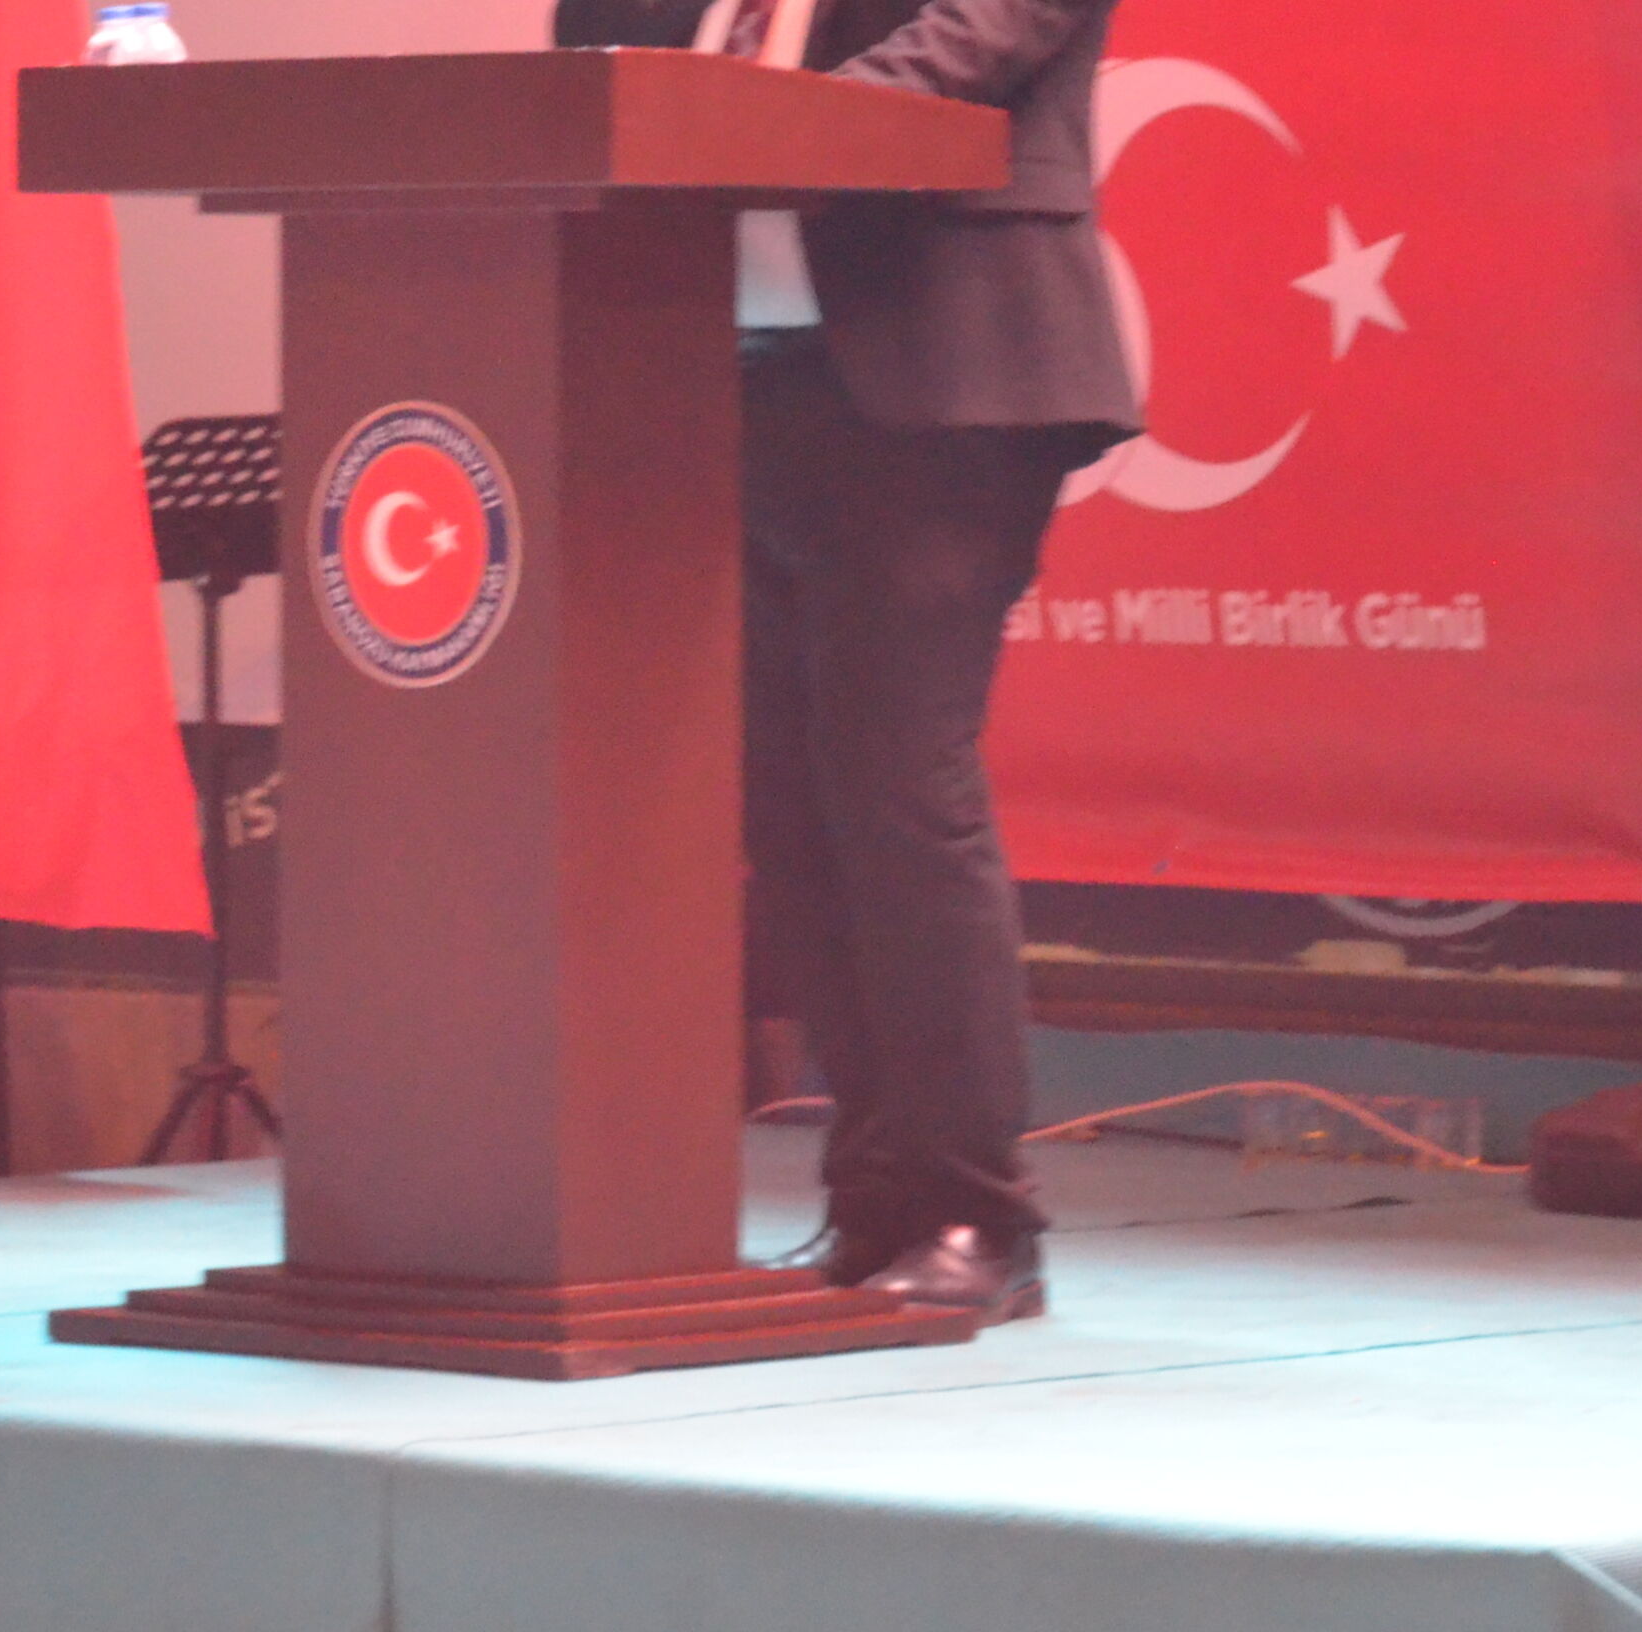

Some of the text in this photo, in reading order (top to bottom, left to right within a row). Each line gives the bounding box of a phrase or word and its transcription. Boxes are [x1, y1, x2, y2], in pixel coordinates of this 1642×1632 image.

[1047, 598, 1107, 643] ve
[1113, 588, 1213, 645] Milli
[1220, 589, 1349, 648] Birlik
[1360, 591, 1487, 651] Günü
